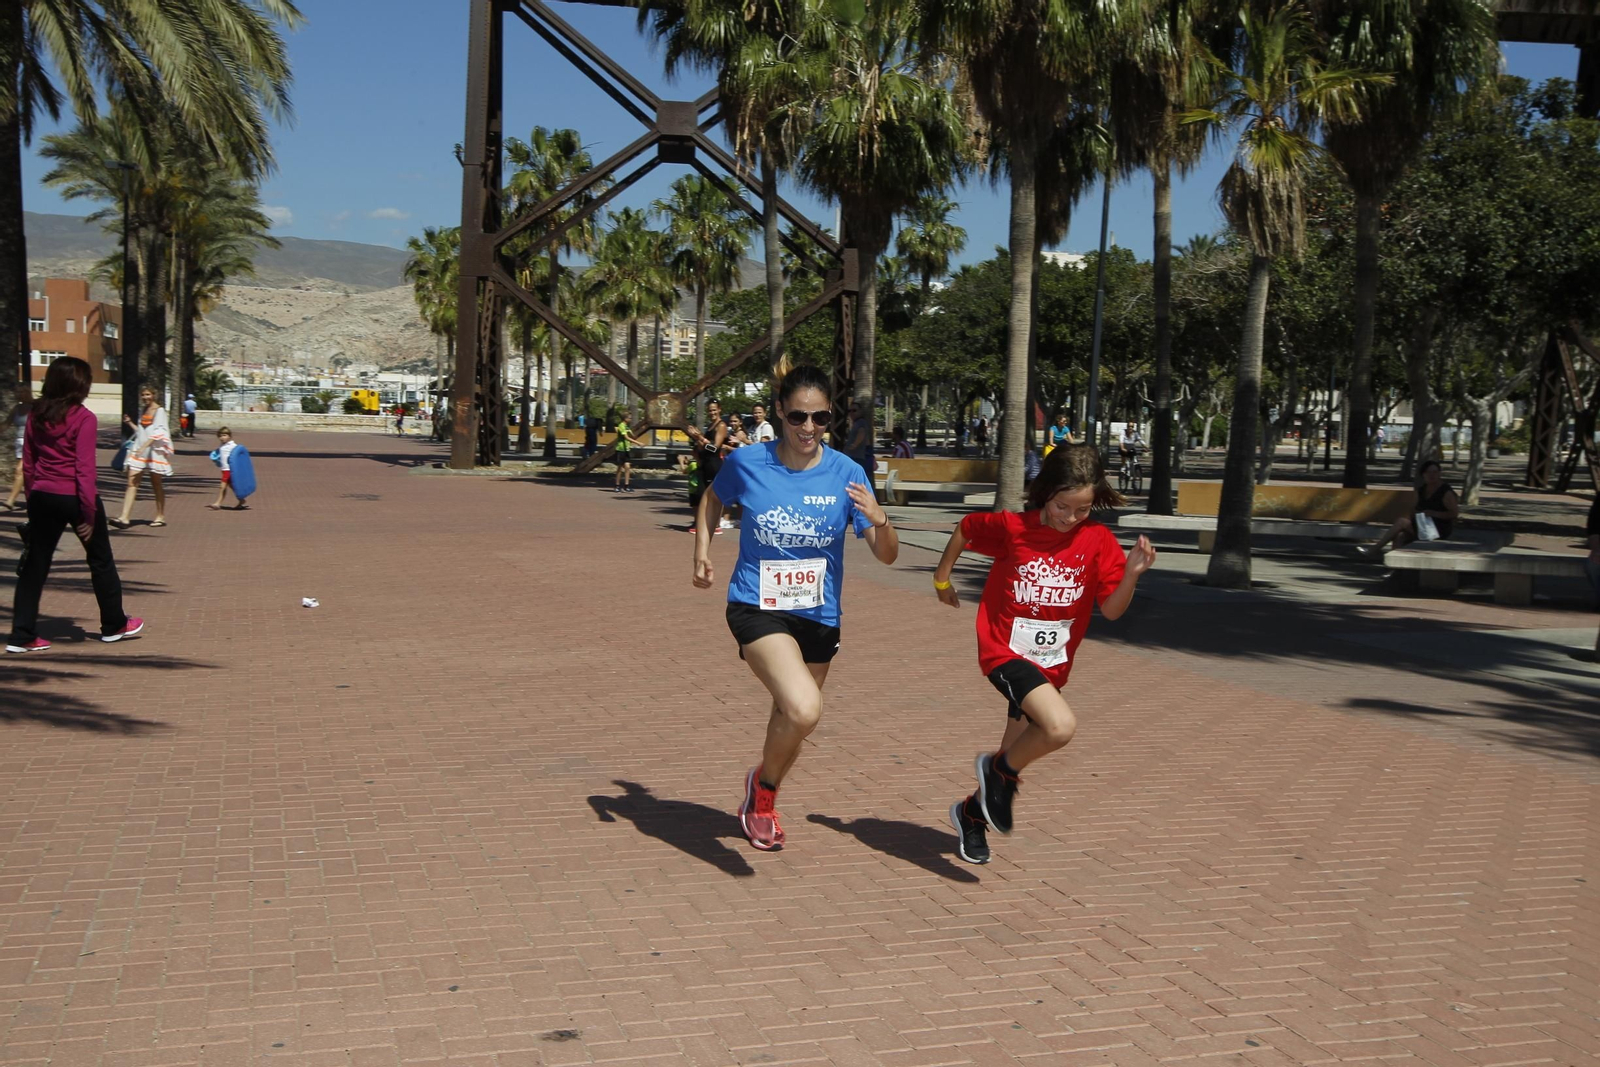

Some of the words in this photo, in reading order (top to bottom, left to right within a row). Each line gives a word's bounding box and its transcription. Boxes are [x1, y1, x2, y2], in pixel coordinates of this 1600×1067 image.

[803, 495, 837, 505] STAFF
[757, 509, 790, 529] ego
[753, 529, 832, 549] WEEKEND
[773, 570, 816, 585] 1196
[1018, 560, 1051, 581] ego
[1013, 580, 1085, 604] WEEKEND
[1034, 630, 1058, 646] 63
